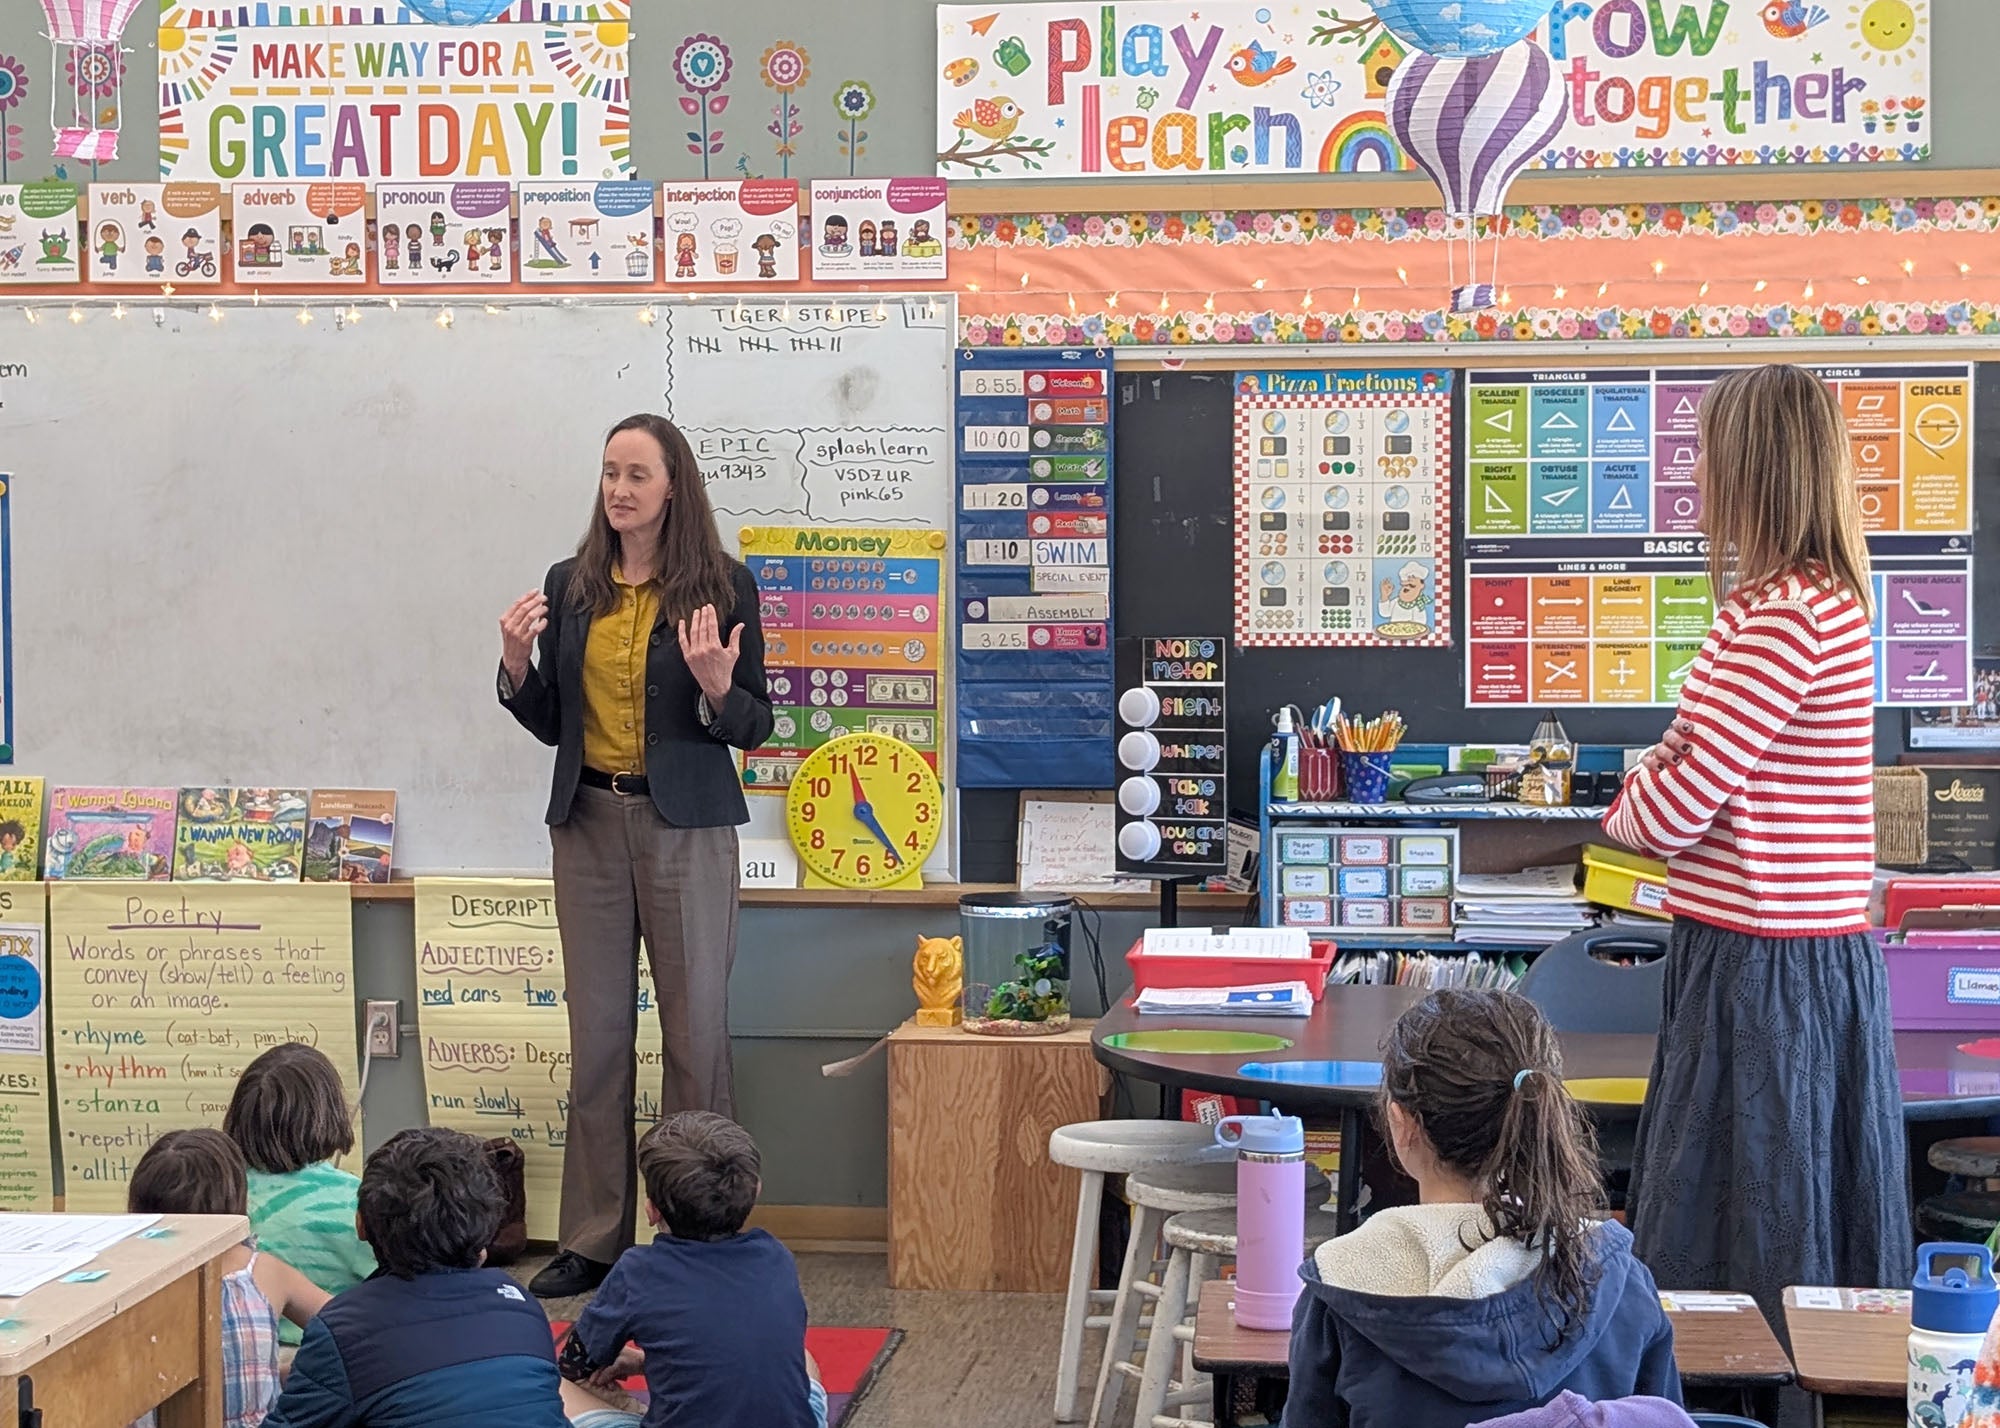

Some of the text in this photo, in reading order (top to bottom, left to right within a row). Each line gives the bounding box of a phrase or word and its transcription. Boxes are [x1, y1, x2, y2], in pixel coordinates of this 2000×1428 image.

[1546, 0, 1731, 61] row
[252, 41, 534, 78] MAKE WAY FOR A
[1048, 4, 1225, 111] play
[1563, 55, 1868, 139] together
[1081, 84, 1303, 173] learn
[209, 102, 578, 178] GREAT DAY!
[100, 188, 136, 205] verb
[243, 188, 296, 206] adverb
[382, 190, 446, 208] pronoun
[523, 188, 591, 205] preposition
[666, 187, 737, 205] interjection
[815, 186, 882, 203] conjunction
[711, 307, 888, 323] TIGER STRIPES
[1266, 372, 1418, 393] Pizza Fractions
[1532, 372, 1587, 381] TRIANGLES
[1825, 369, 1861, 377] CIRCLE
[1477, 389, 1520, 398] SCALENE
[1534, 388, 1586, 397] ISOSCELES
[1595, 387, 1647, 395] EQUILATERAL
[1910, 385, 1962, 397] CIRCLE
[1481, 398, 1517, 406] TRIANGLE
[700, 437, 770, 454] EPIC
[974, 430, 1022, 449] 10:00
[1484, 465, 1513, 473] RIGHT
[1540, 465, 1578, 473] OBTUSE
[1605, 464, 1636, 473] ACUTE
[841, 487, 903, 506] pink65
[794, 531, 892, 557] Money
[985, 541, 1019, 560] 1:10
[1036, 541, 1097, 564] SWIM
[1643, 541, 1694, 554] BASIC
[1558, 563, 1586, 571] LINES
[1598, 563, 1626, 571] MORE
[1036, 572, 1108, 583] SPECIAL EVENT
[1549, 579, 1571, 587] LINE
[1603, 585, 1641, 593] SEGMENT
[1027, 606, 1096, 620] ASSEMBLY
[1152, 661, 1218, 680] meter
[1162, 697, 1221, 716] silent
[853, 745, 878, 765] 12
[1161, 744, 1224, 760] whisper
[828, 753, 848, 774] 11
[889, 753, 898, 773] 1
[807, 777, 831, 798] 10
[907, 772, 921, 793] 2
[1168, 778, 1216, 796] Table
[55, 789, 173, 810] I Wanna Iguana
[1175, 797, 1210, 815] talk
[801, 802, 816, 823] 9
[915, 802, 930, 823] 3
[178, 825, 303, 844] I WANNA NEW ROOM
[810, 829, 825, 849] 8
[904, 830, 919, 851] 4
[830, 849, 846, 869] 7
[856, 855, 870, 876] 6
[883, 848, 898, 869] 5
[745, 861, 776, 879] au
[126, 896, 222, 934] Poetry
[451, 895, 553, 917] DESCRIPT
[66, 935, 326, 968] Words or phrases that
[421, 941, 555, 966] ADJECTIVES:
[84, 961, 345, 1000] convey (show/tell) a feeling
[1958, 977, 2000, 991] Llamas
[423, 979, 557, 1003] red cars two
[92, 991, 229, 1015] or an image.
[74, 1021, 147, 1055] rhyme
[428, 1037, 516, 1065] ADVERBS:
[76, 1055, 167, 1088] rhythm
[213, 1064, 223, 1078] it
[76, 1088, 160, 1113] stanza
[431, 1087, 523, 1119] run slowly
[511, 1124, 536, 1141] act
